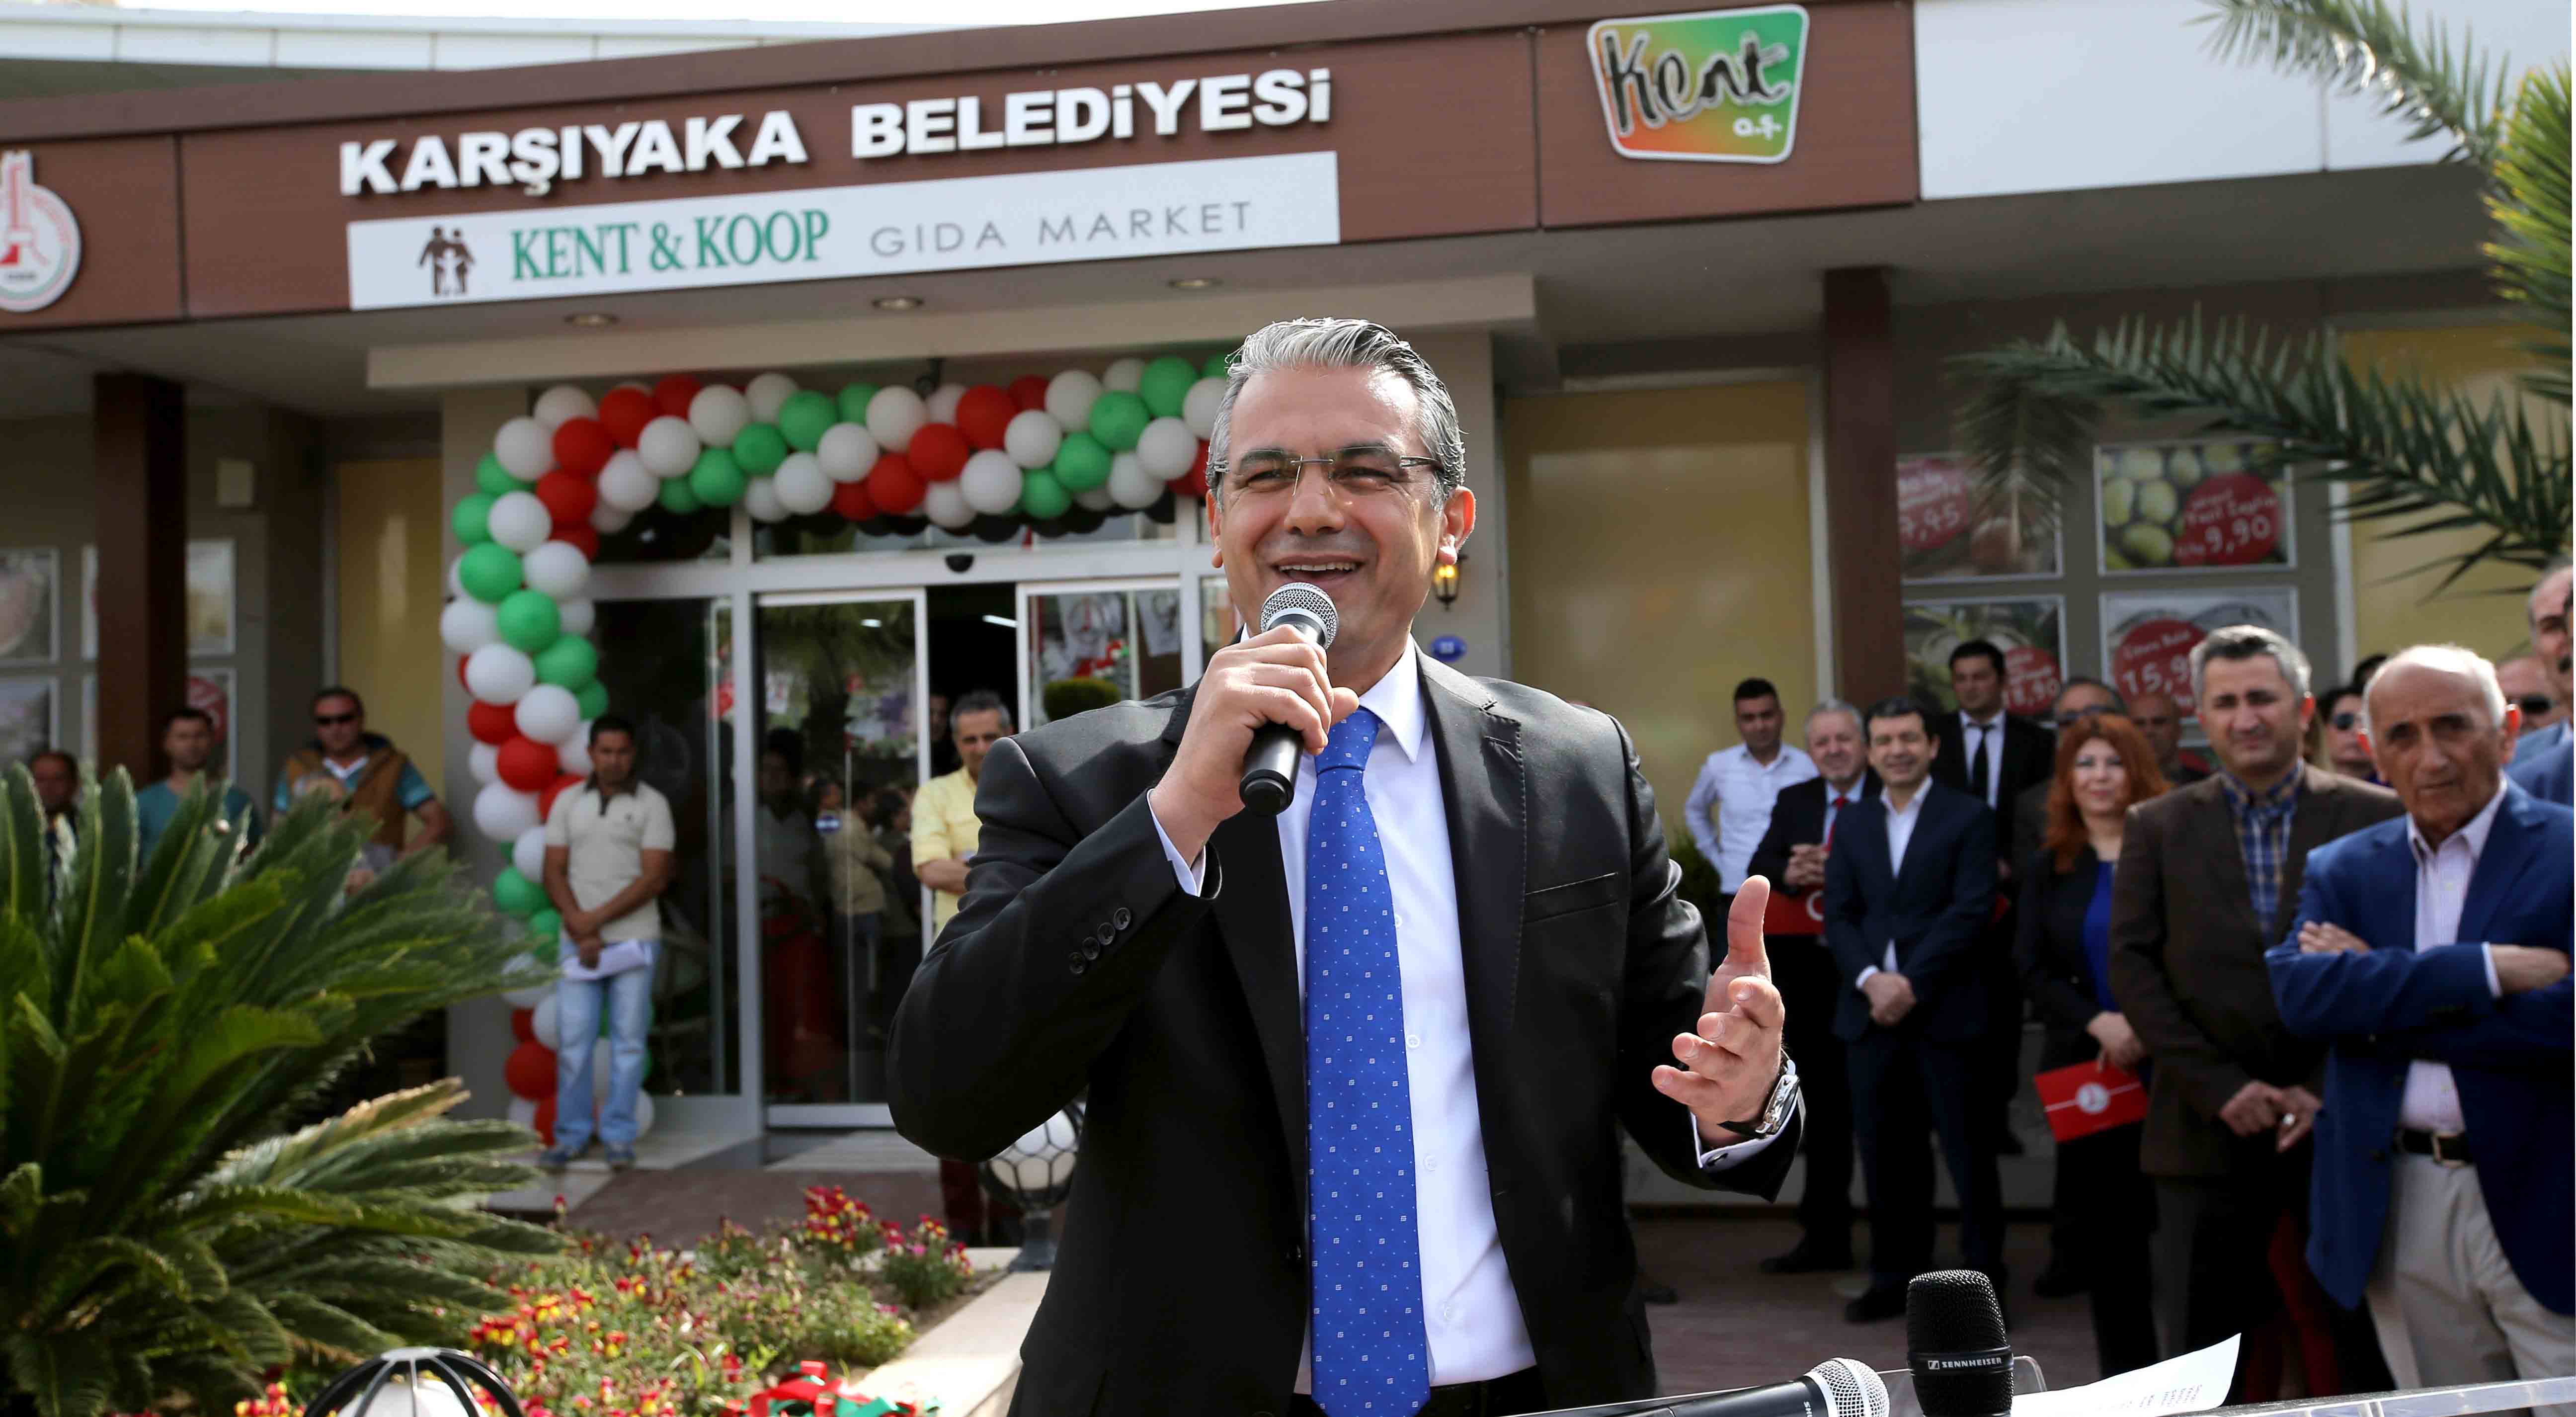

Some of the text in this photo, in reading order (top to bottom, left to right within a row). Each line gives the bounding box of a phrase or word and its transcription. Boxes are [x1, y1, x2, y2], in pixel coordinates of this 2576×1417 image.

[1601, 30, 1792, 135] Kent
[340, 110, 808, 195] KARŞIYAKA
[510, 201, 1252, 281] KENT & KOOP GIDA MARKET
[2123, 654, 2189, 695] 15,9
[1941, 1357, 2002, 1368] SENNHEISER
